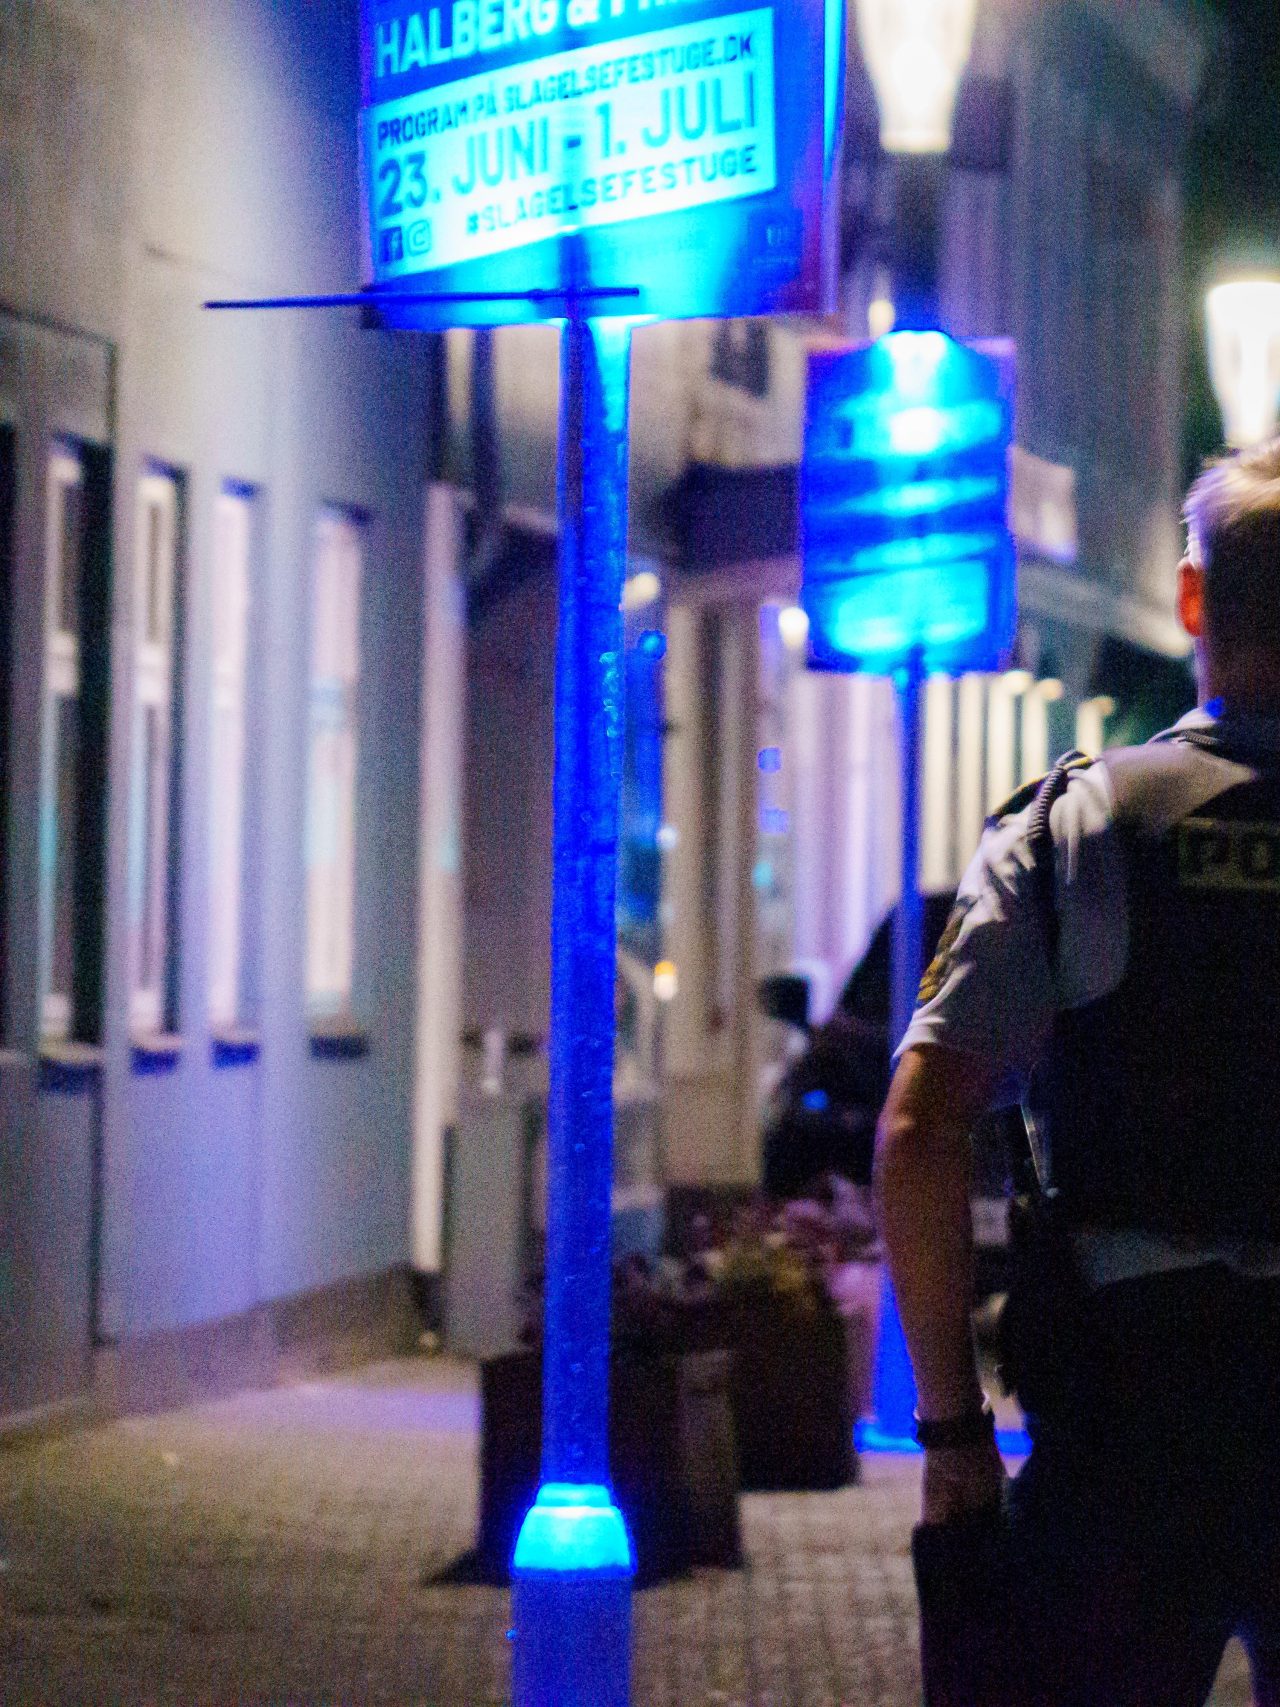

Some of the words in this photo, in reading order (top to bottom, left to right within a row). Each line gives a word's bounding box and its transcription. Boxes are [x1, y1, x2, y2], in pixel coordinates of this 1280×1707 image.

[375, 0, 558, 78] HALBERG
[377, 101, 467, 150] PROGRAM
[504, 31, 753, 113] SLAGELSEFESTUGE.DK
[379, 150, 441, 218] 23.
[452, 122, 549, 195] JUNI
[596, 100, 626, 160] 1.
[642, 70, 756, 148] JULI
[466, 144, 757, 235] #SLAGELSEFESTUGE
